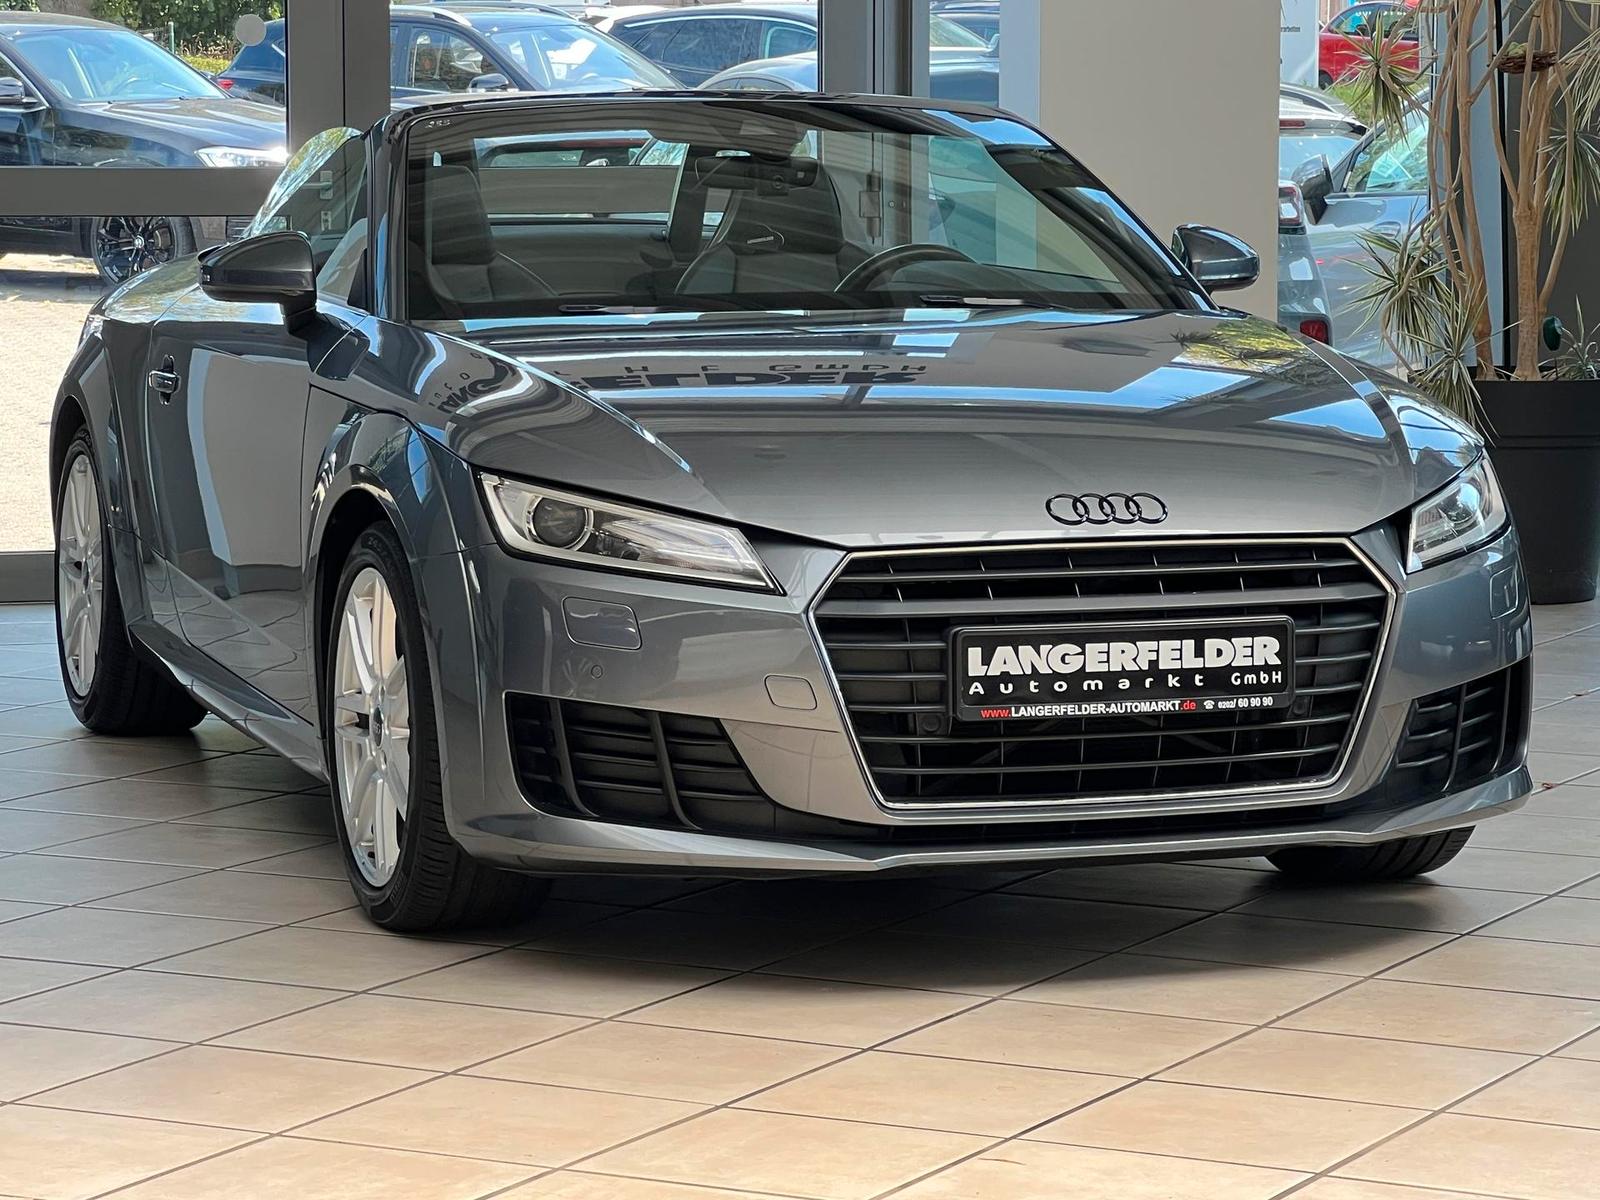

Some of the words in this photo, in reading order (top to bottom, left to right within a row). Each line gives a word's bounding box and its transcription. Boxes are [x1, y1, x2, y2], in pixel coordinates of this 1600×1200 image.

[967, 636, 1282, 677] LANGERFELDER
[968, 673, 1204, 695] Automarkt
[1231, 671, 1282, 686] GmbH
[980, 699, 1197, 719] www.LANGERFELDER-AUTOMARKT.de
[1237, 697, 1249, 708] 60
[1250, 697, 1261, 707] 90
[1262, 696, 1274, 706] 90
